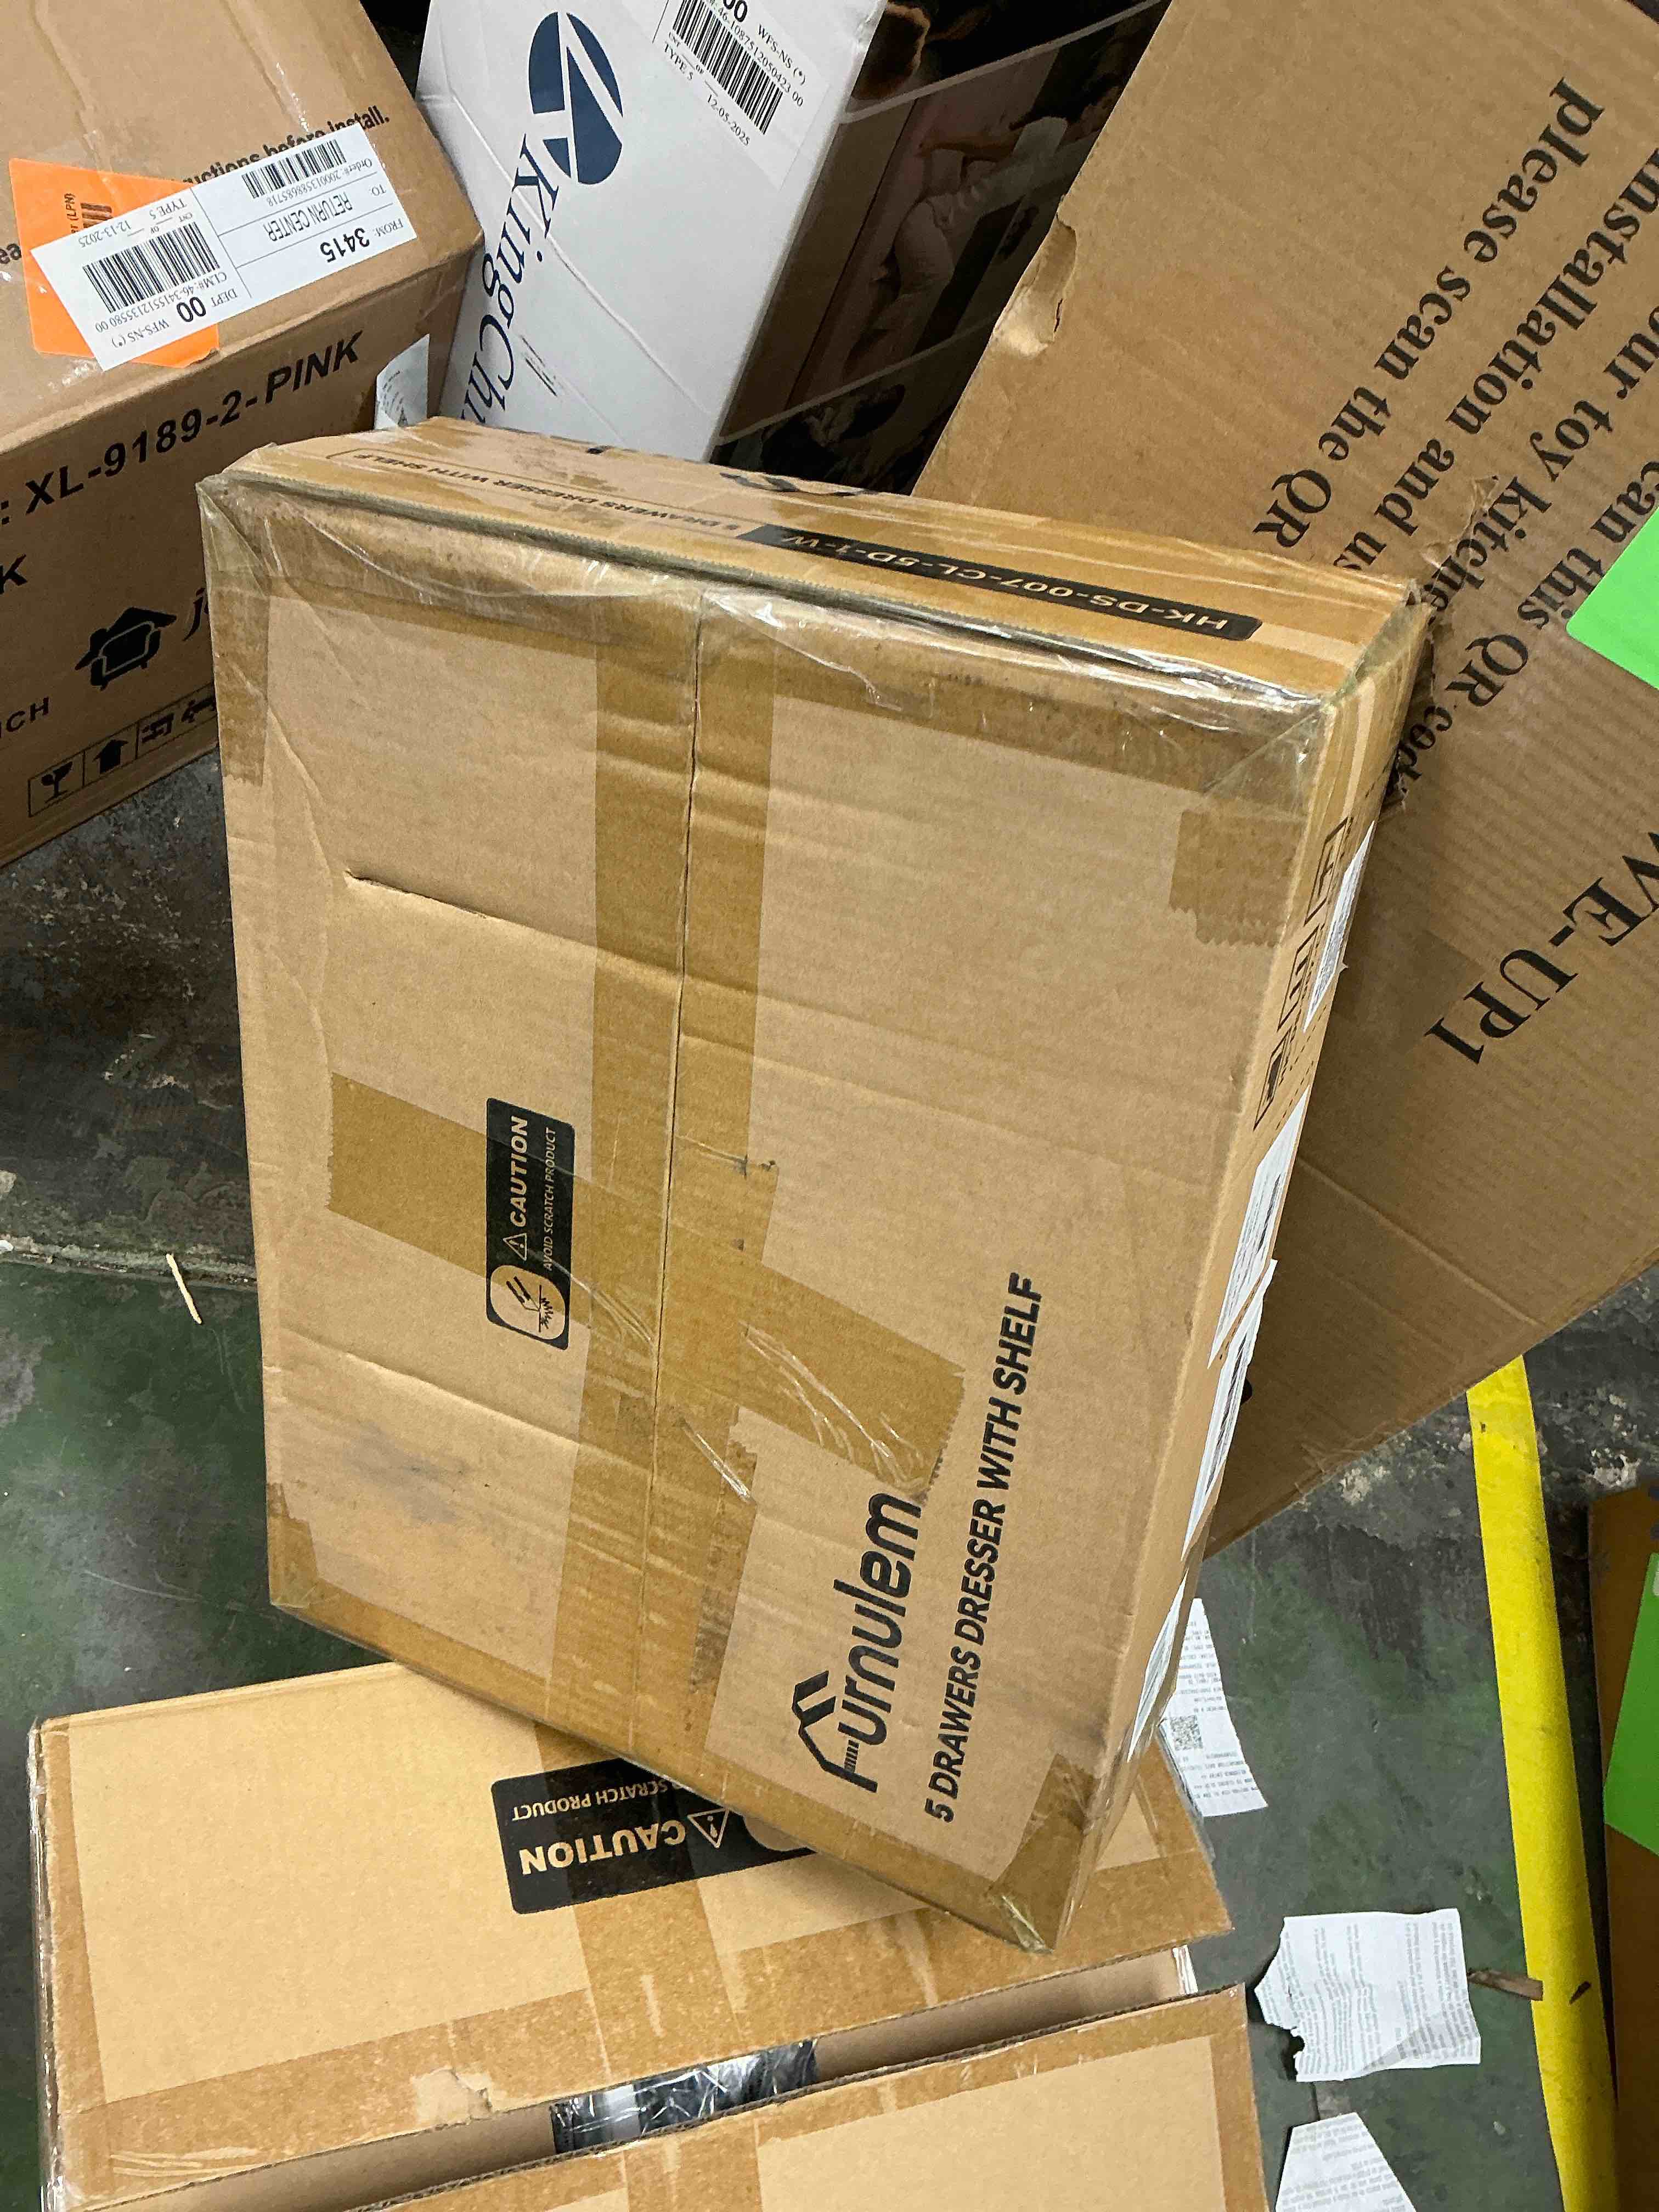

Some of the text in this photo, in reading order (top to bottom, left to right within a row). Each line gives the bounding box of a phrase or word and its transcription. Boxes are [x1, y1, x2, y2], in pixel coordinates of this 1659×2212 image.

[759, 25, 792, 68] WFS-NS
[708, 94, 749, 145] 12-05-2025
[792, 92, 803, 106] 00
[78, 221, 132, 247] 12-13-2025
[263, 210, 310, 241] CENTER
[307, 193, 352, 224] RETURN
[320, 228, 369, 262] 3415
[177, 297, 206, 322] 00
[211, 289, 237, 307] DEPT
[460, 133, 559, 424] KingChi
[1446, 148, 1659, 435] nstallation
[95, 321, 108, 332] 00
[127, 319, 169, 342] WFS-NS
[1252, 77, 1605, 548] please scan the QR
[26, 330, 363, 515] XL-9189-2-PINK
[1530, 400, 1613, 481] toy
[1374, 439, 1454, 535] and
[1423, 476, 1552, 617] kitche
[1517, 548, 1605, 629] this
[1446, 634, 1528, 707] QR
[1396, 706, 1453, 781] cod
[510, 1116, 528, 1228] CAUTION
[543, 1128, 556, 1272] AVOID SCRATCH PRODUCT
[924, 1272, 1042, 1822] 5 DRAWERS DRESSER WITH SHELF
[512, 1781, 668, 1821] SCRATCH PRODUCT
[519, 1820, 687, 1875] CAUTION
